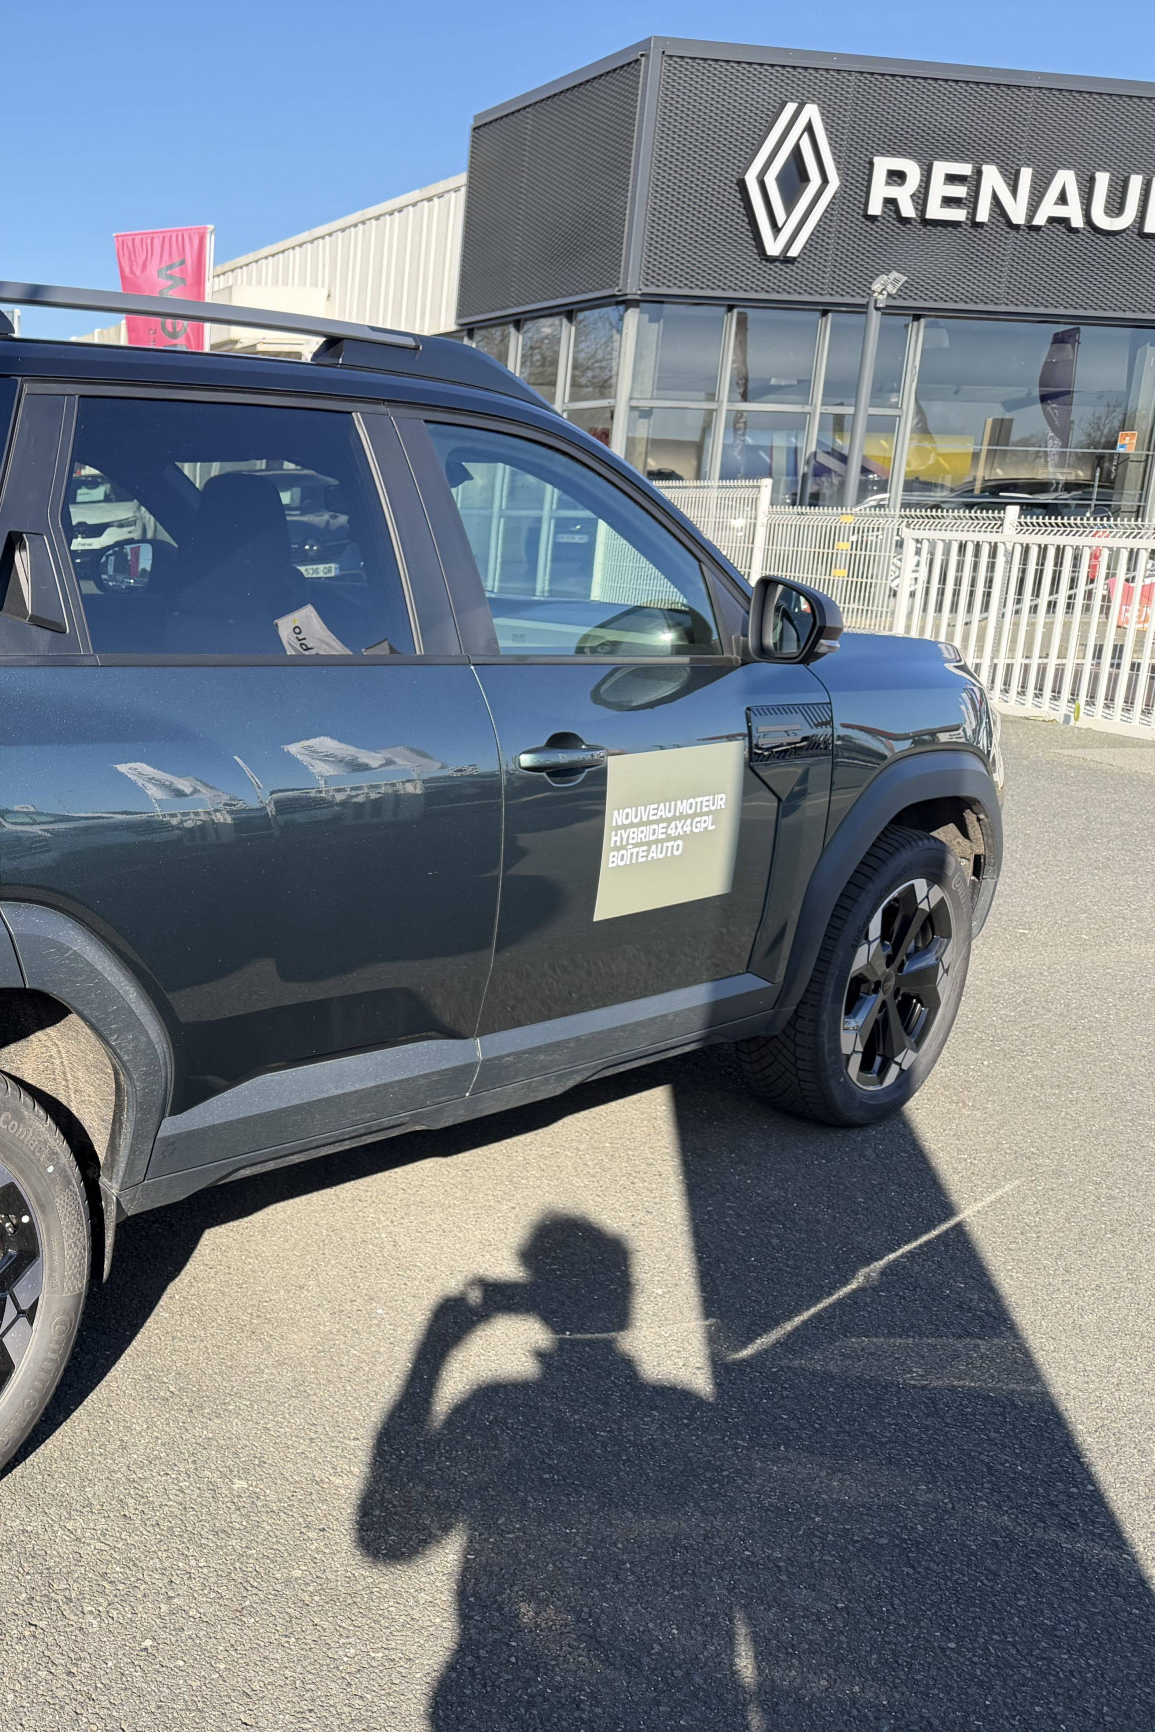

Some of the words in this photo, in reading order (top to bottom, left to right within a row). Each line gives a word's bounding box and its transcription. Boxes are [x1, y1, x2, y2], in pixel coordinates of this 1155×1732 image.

[612, 802, 675, 826] NOUVEAU
[676, 794, 726, 816] MOTEUR
[610, 823, 667, 847] HYBRIDE
[667, 819, 691, 836] 4X4
[692, 815, 715, 833] GPL
[608, 842, 648, 868] BOÎTE
[648, 840, 683, 861] AUTO
